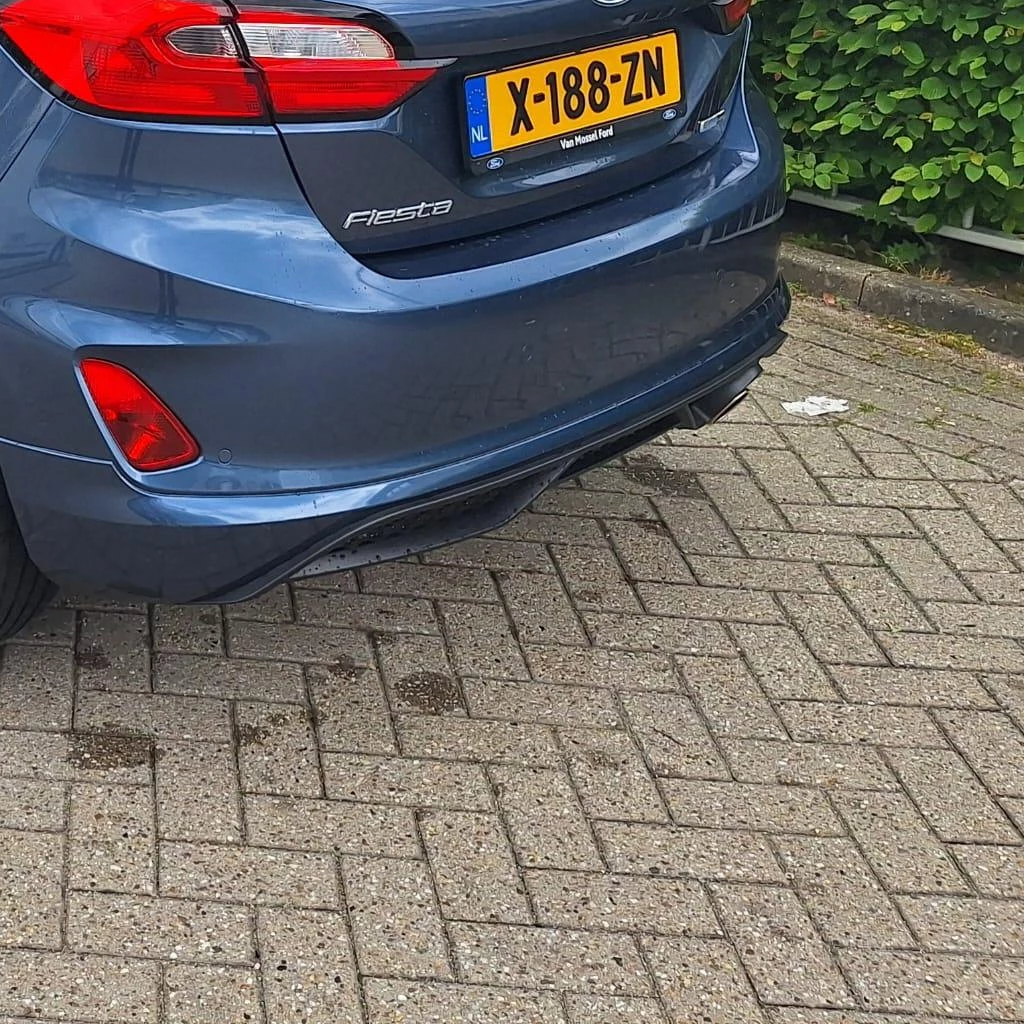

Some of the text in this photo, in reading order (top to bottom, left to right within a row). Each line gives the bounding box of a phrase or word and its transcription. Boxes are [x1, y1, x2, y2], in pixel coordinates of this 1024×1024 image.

[507, 46, 666, 136] X-188-ZN
[471, 126, 488, 143] NL
[560, 125, 614, 150] Van Mossel Ford
[342, 199, 453, 229] Fiesta
